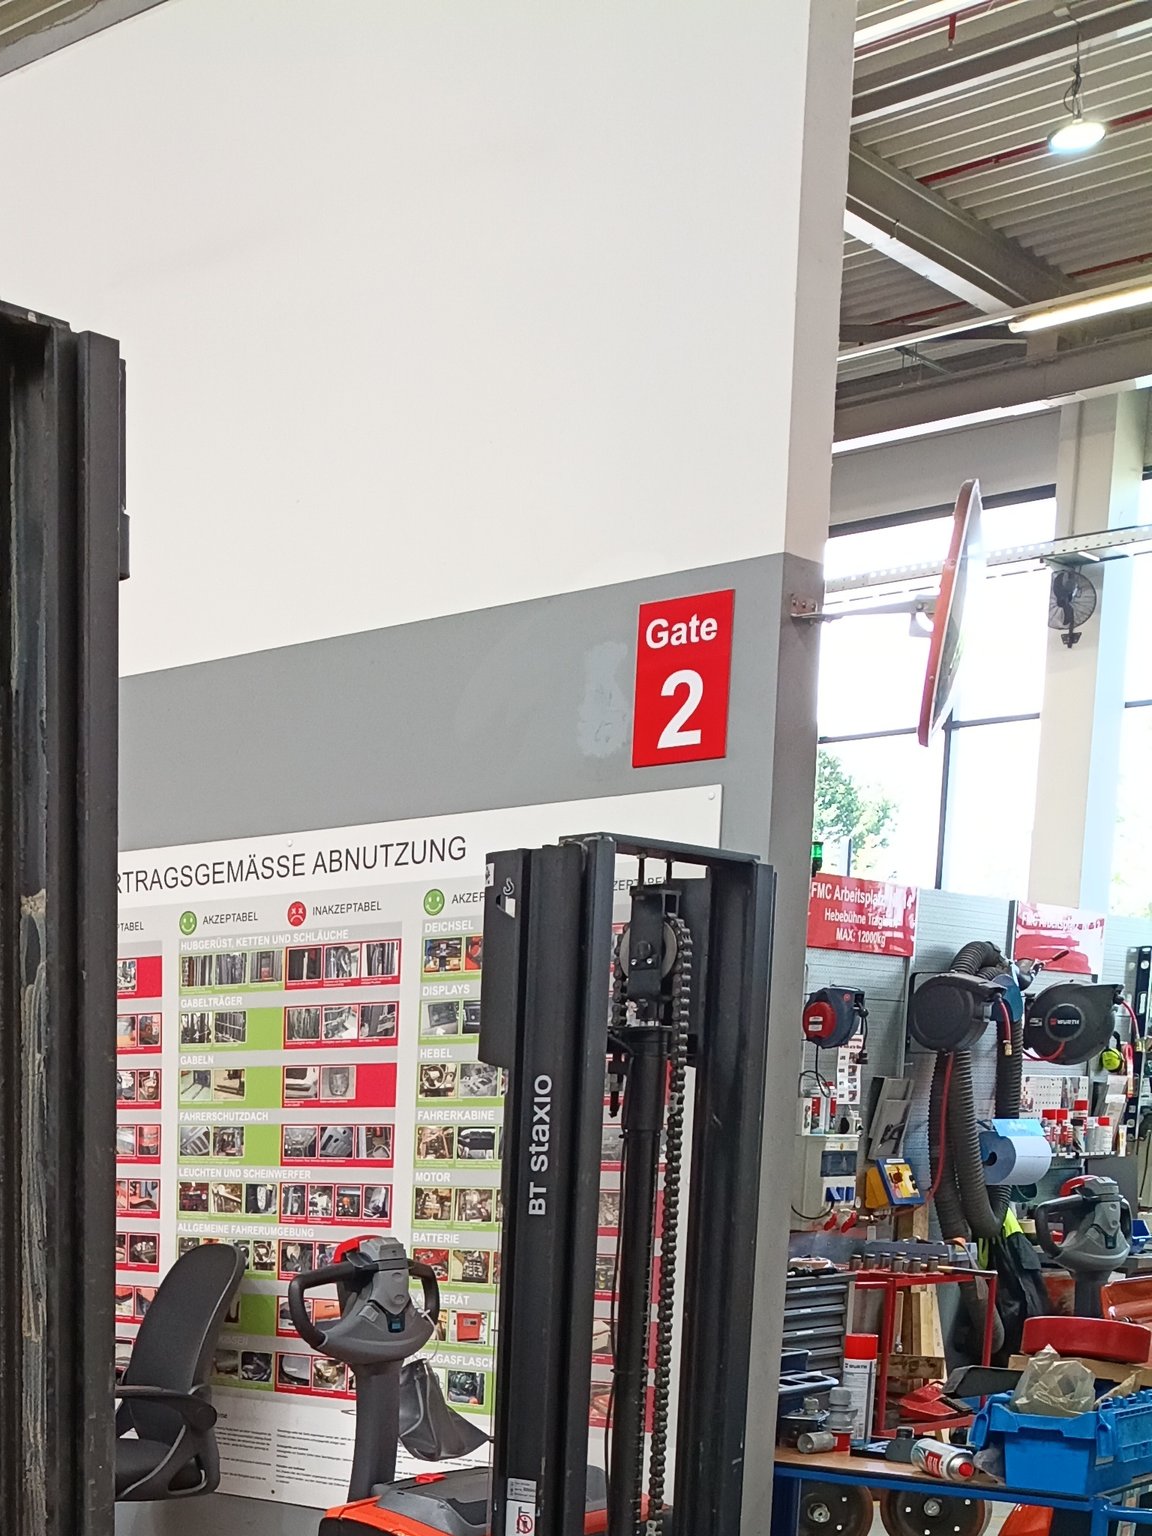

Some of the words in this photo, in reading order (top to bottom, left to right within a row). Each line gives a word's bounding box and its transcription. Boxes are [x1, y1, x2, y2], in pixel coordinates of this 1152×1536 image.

[645, 613, 718, 649] Gate
[657, 669, 704, 750] 2
[312, 836, 467, 875] ABNUTZUNG
[811, 881, 833, 900] FMC
[312, 900, 382, 916] INAKZEPTABEL
[202, 911, 259, 926] AKZEPTABEL
[824, 908, 867, 925] Hebebühne
[118, 921, 145, 932] TABEL
[424, 919, 475, 933] DEICHSEL
[180, 936, 234, 951] HUBGERÜST,
[235, 934, 271, 947] KETTEN
[273, 932, 291, 944] UND
[293, 928, 349, 943] SCHLÄUCHE
[836, 927, 856, 942] MAX:
[422, 983, 471, 996] DISPLAYS
[180, 995, 243, 1009] GABELTRÄGER
[180, 1055, 214, 1065] GABELN
[420, 1048, 453, 1059] HEBEL
[179, 1111, 269, 1121] FAHRERSCHUTZDACH
[417, 1110, 496, 1121] FAHRERKABINE
[178, 1167, 222, 1178] LEUCHTEN
[223, 1168, 242, 1178] UND
[243, 1168, 312, 1180] SCHEINWERFER
[415, 1172, 451, 1182] MOTOR
[528, 1181, 547, 1216] BT
[177, 1222, 229, 1234] ALLGEMEINE
[231, 1225, 315, 1238] FAHRERUMGEBUNG
[412, 1232, 460, 1244] BATTERIE
